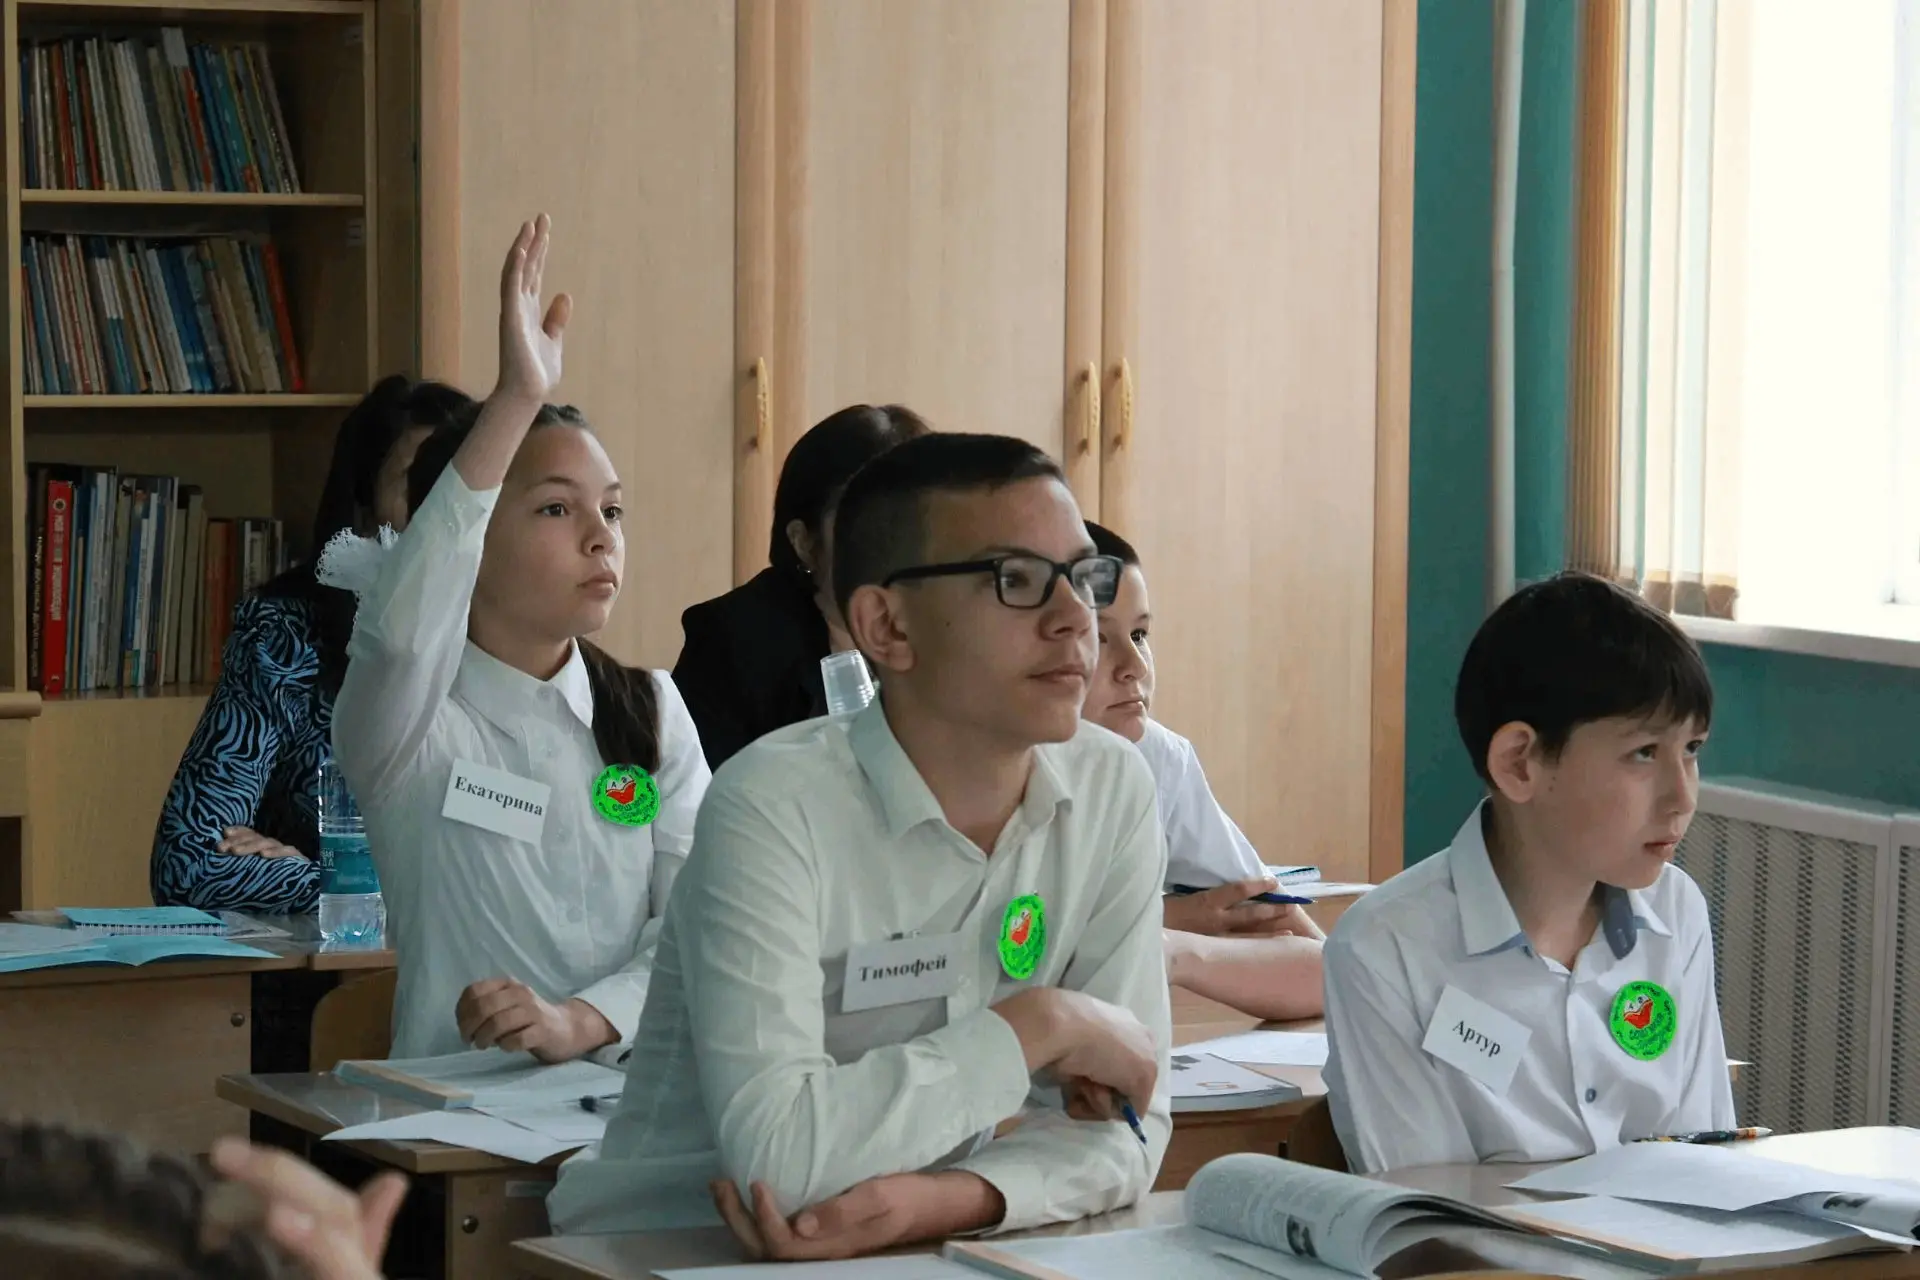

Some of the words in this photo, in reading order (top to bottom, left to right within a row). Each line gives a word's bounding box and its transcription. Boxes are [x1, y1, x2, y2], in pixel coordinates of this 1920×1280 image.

[455, 776, 543, 816] Екатерина
[859, 954, 947, 982] Тимофей
[1452, 1020, 1501, 1058] Артур
